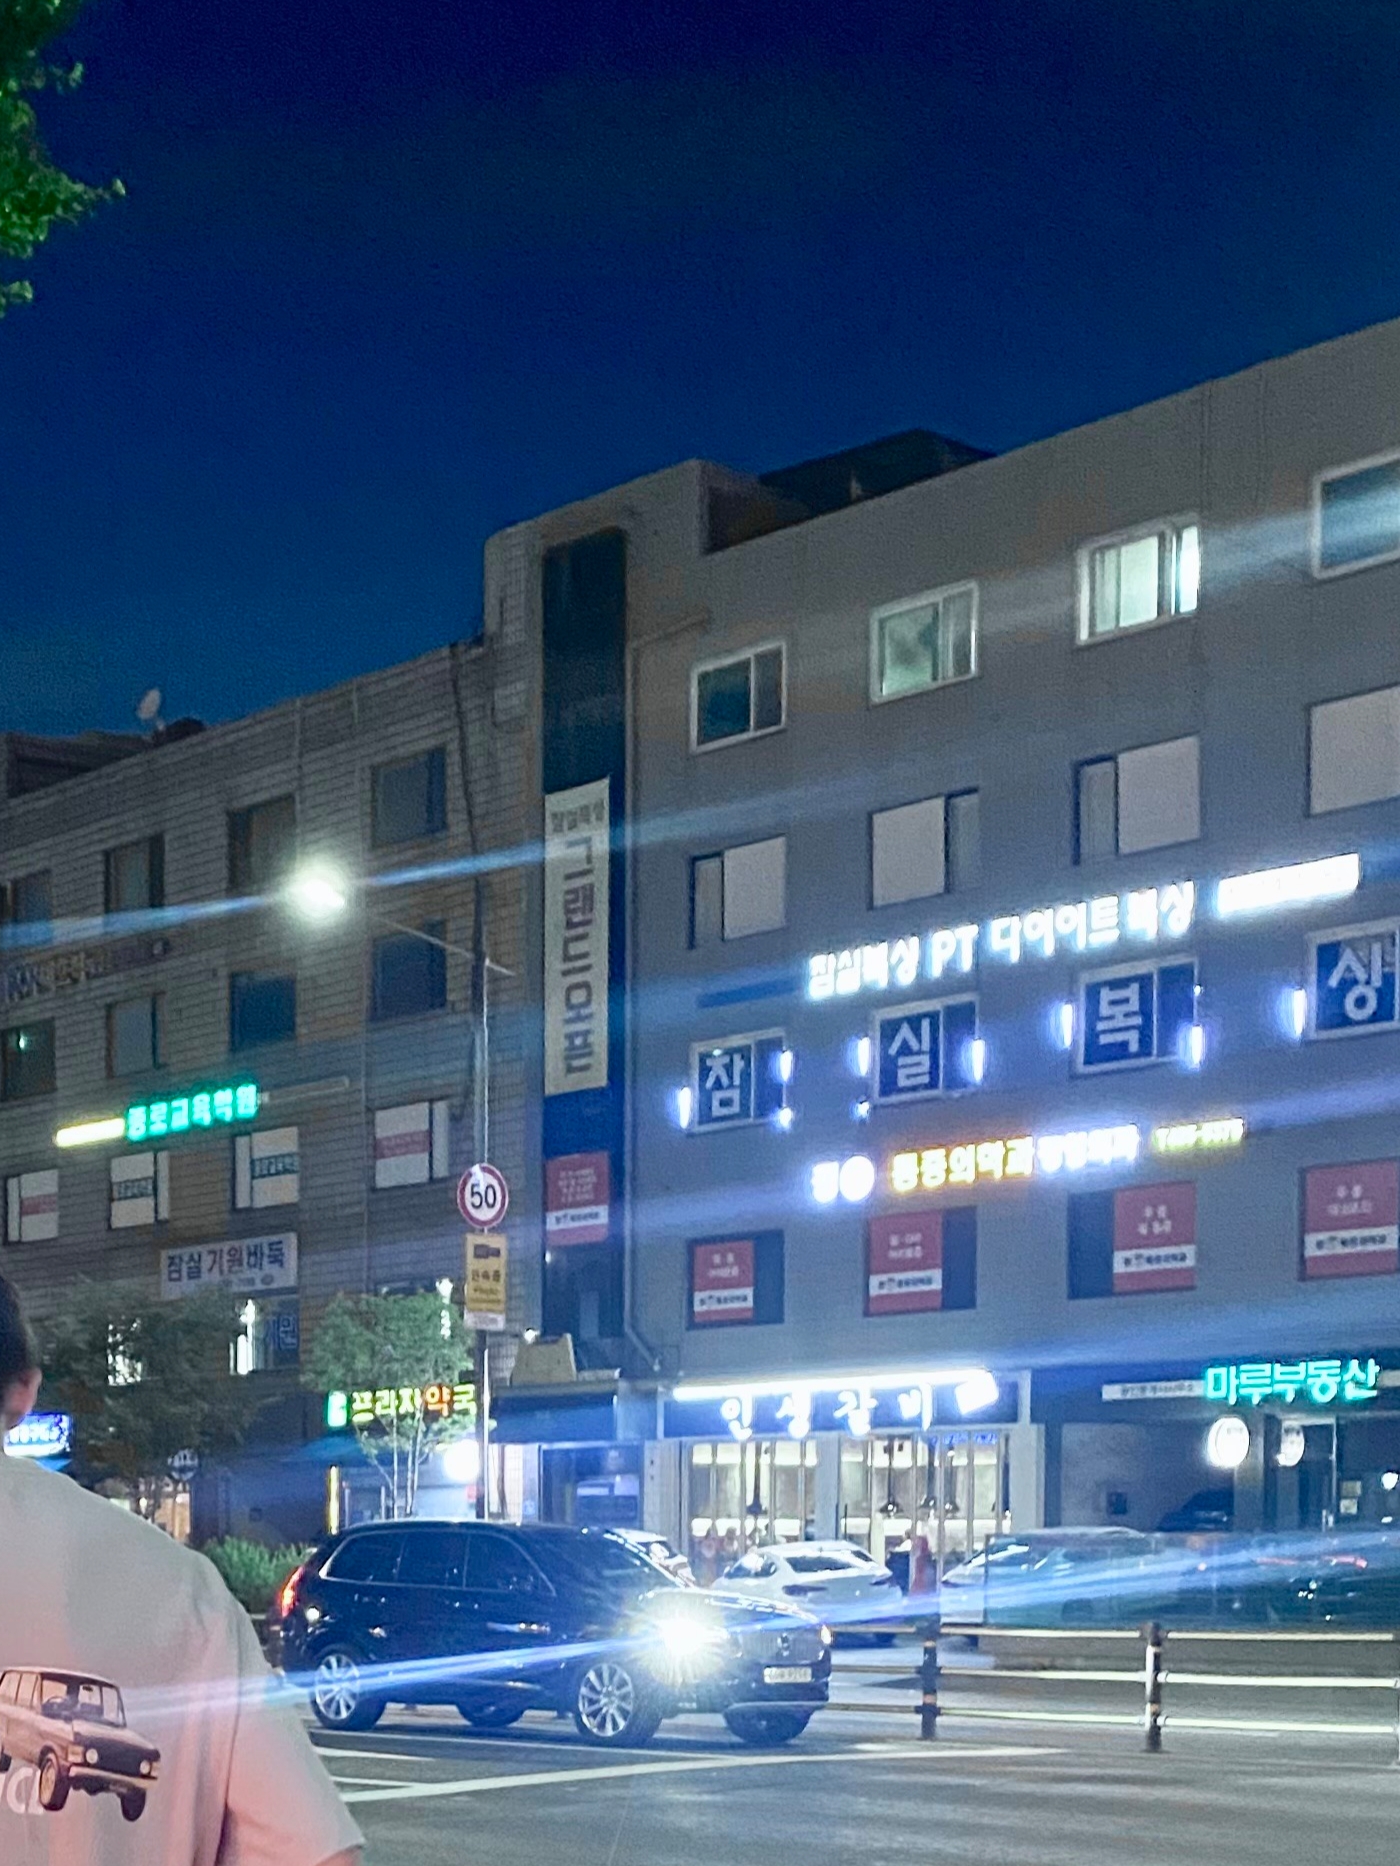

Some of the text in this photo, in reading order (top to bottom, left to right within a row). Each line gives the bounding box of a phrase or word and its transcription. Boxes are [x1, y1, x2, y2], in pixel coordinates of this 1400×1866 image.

[809, 937, 920, 999] 잠실복싱
[931, 925, 979, 977] PT
[990, 896, 1121, 963] 다이어트
[470, 1183, 497, 1210] 50
[1206, 1358, 1380, 1405] 마루부동산
